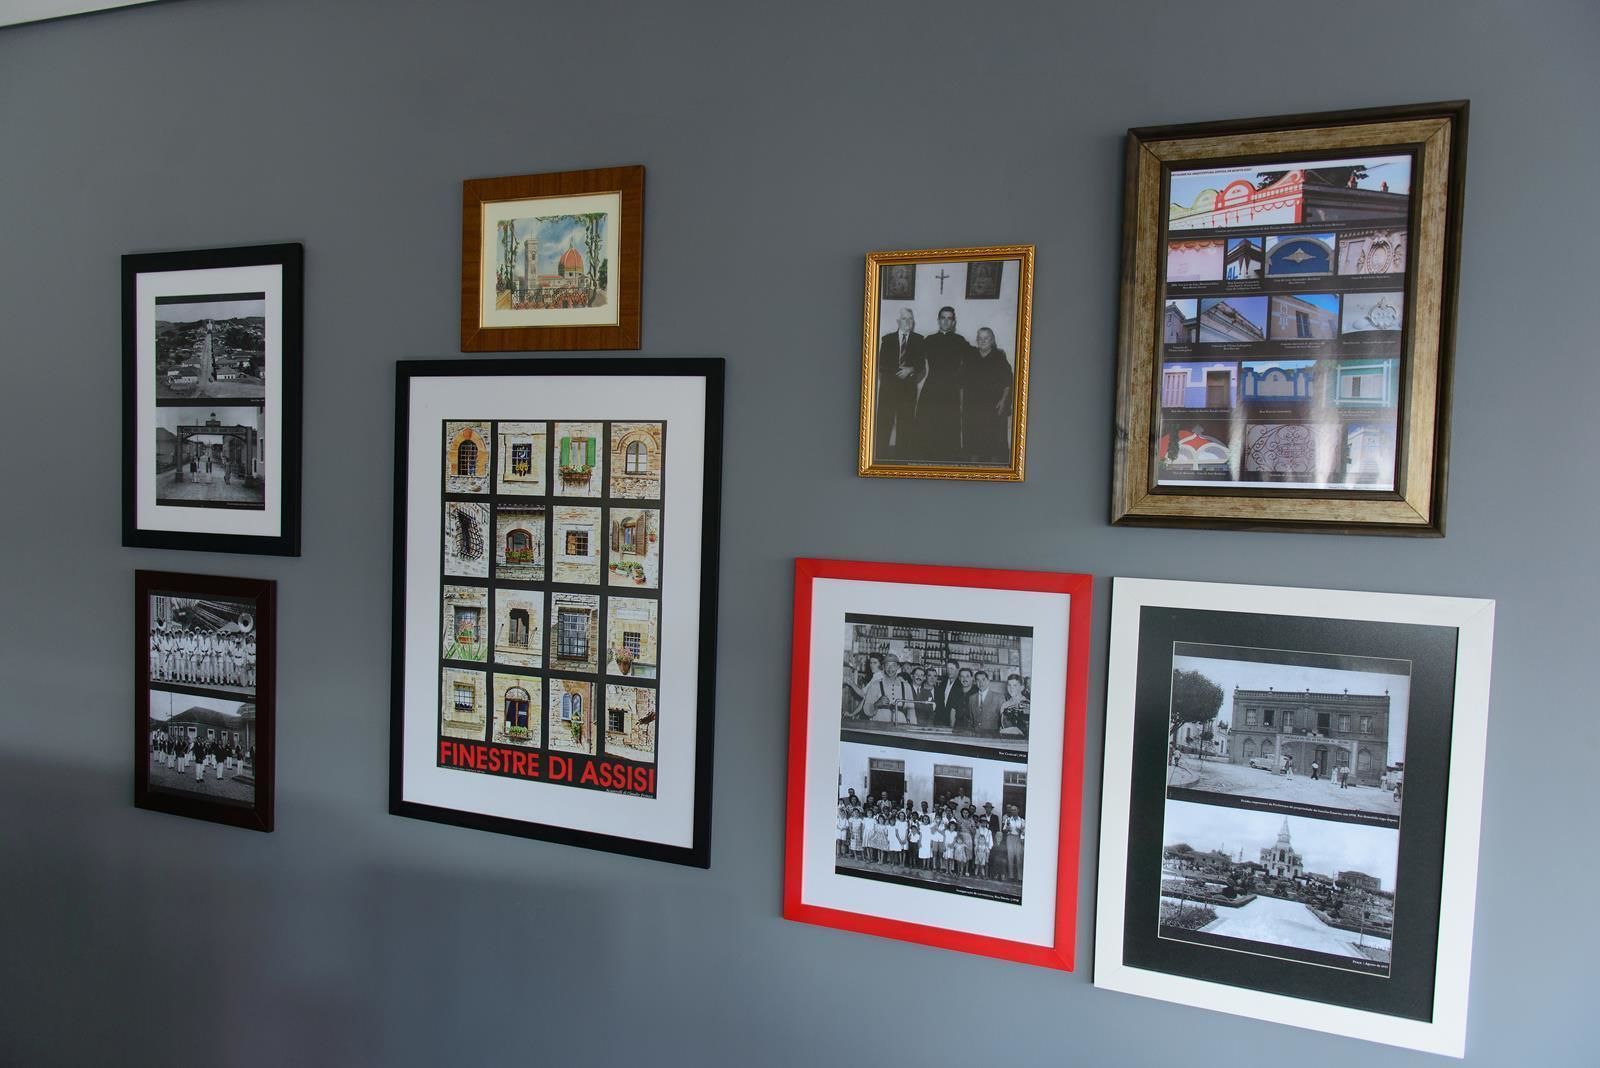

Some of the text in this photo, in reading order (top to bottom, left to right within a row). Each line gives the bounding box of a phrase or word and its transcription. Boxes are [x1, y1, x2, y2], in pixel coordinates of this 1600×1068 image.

[440, 741, 655, 793] FINESTRE DI ASSISI
